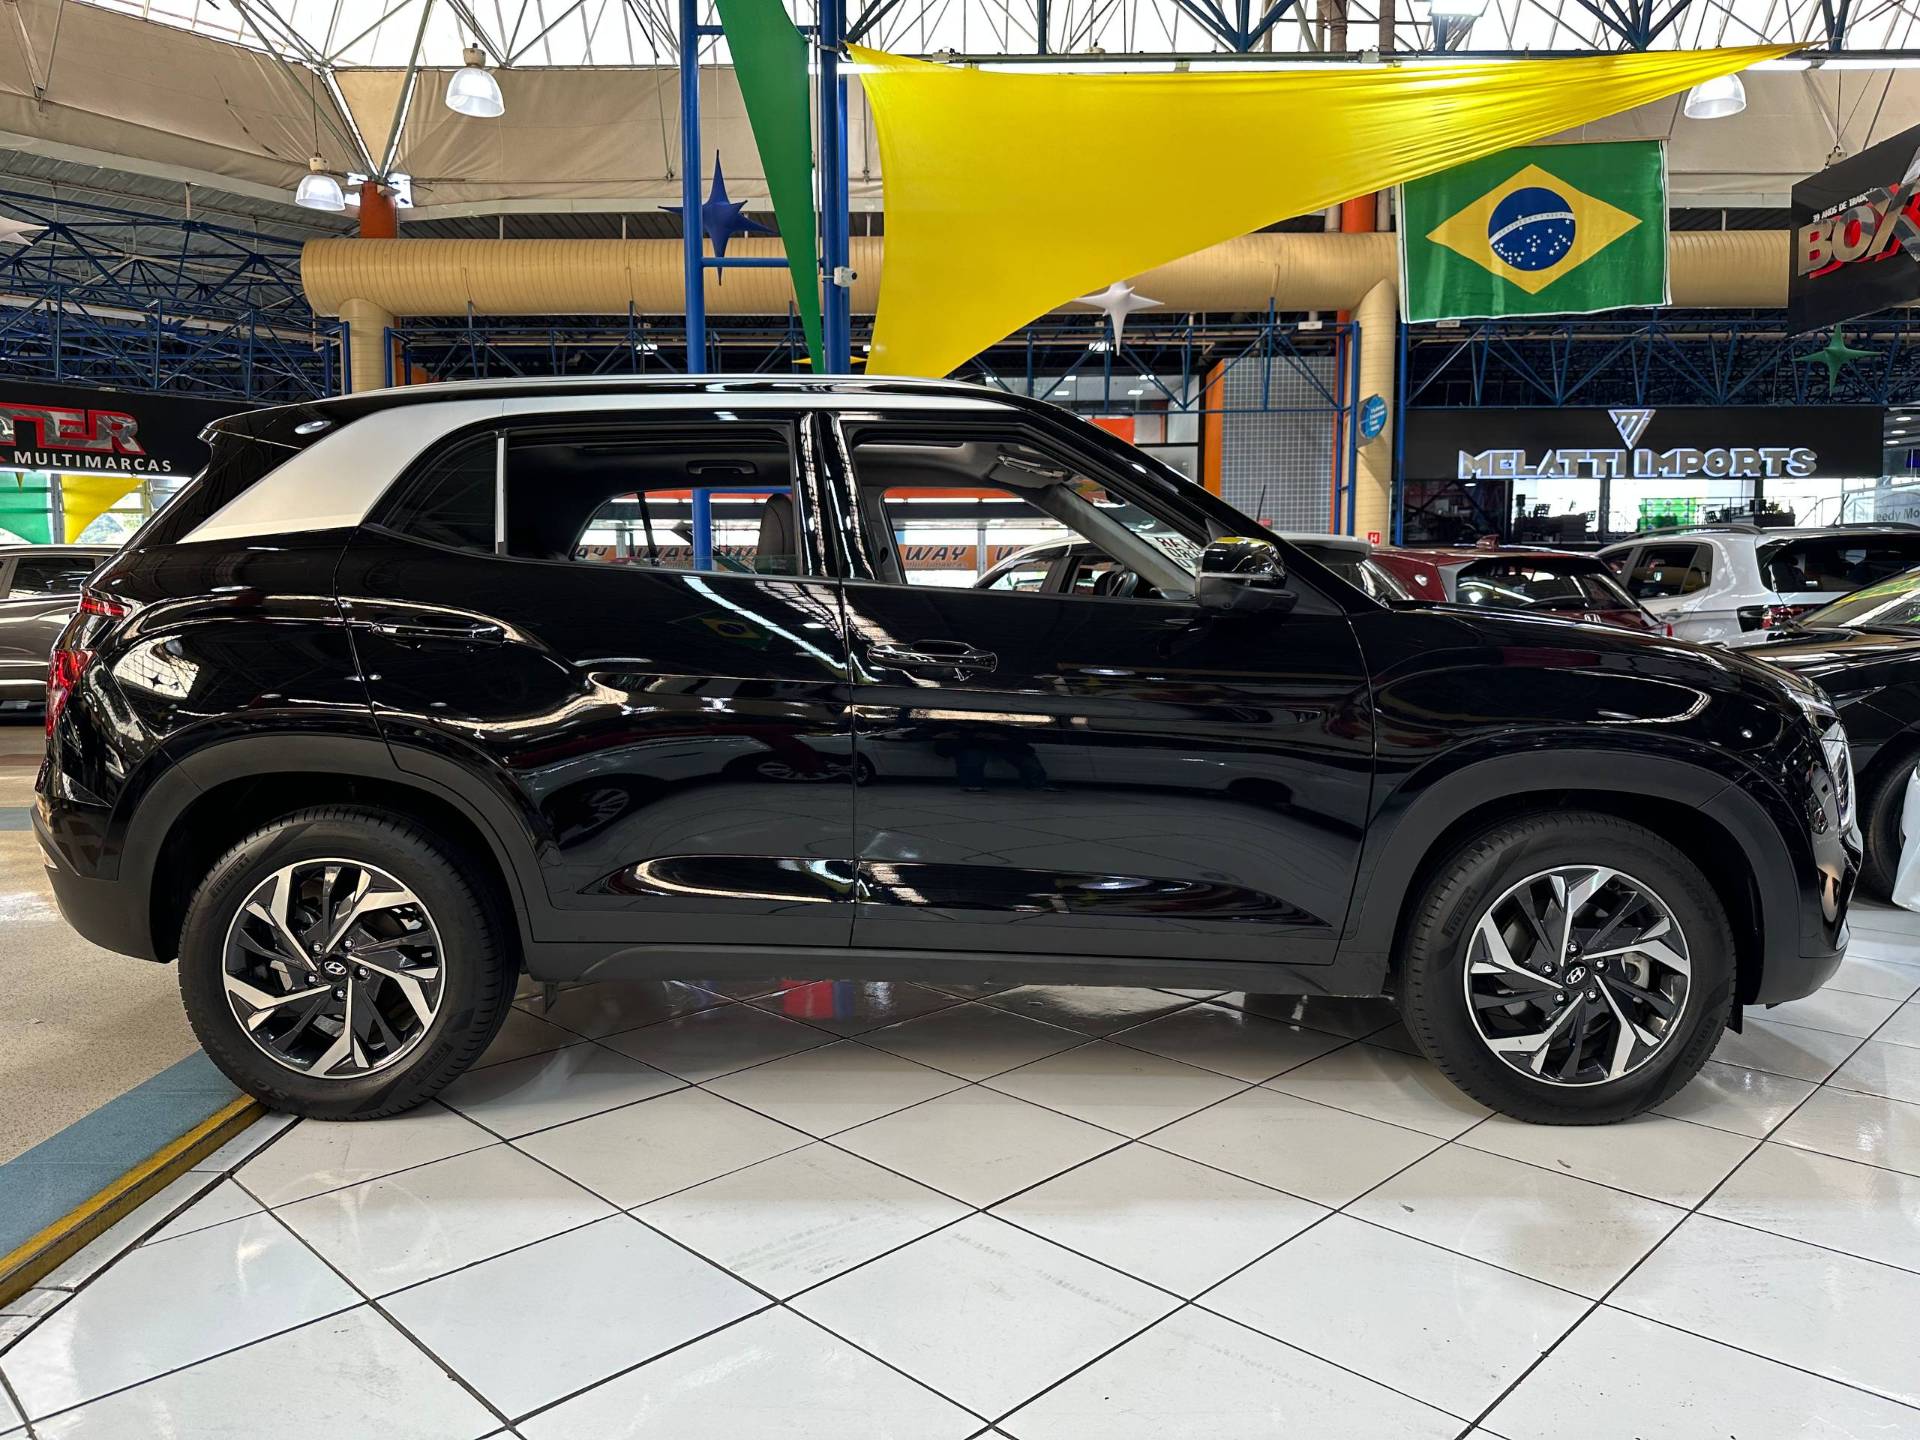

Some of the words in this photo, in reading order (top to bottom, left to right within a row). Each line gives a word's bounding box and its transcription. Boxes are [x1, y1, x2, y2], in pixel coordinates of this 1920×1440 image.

[1821, 205, 1838, 219] ANOS
[1839, 201, 1847, 211] DE
[14, 450, 172, 472] MULTIMARCAS
[1458, 449, 1627, 480] MELATTI
[1633, 448, 1817, 477] IMPORTS
[1873, 511, 1902, 522] eedy
[905, 546, 967, 561] WAY
